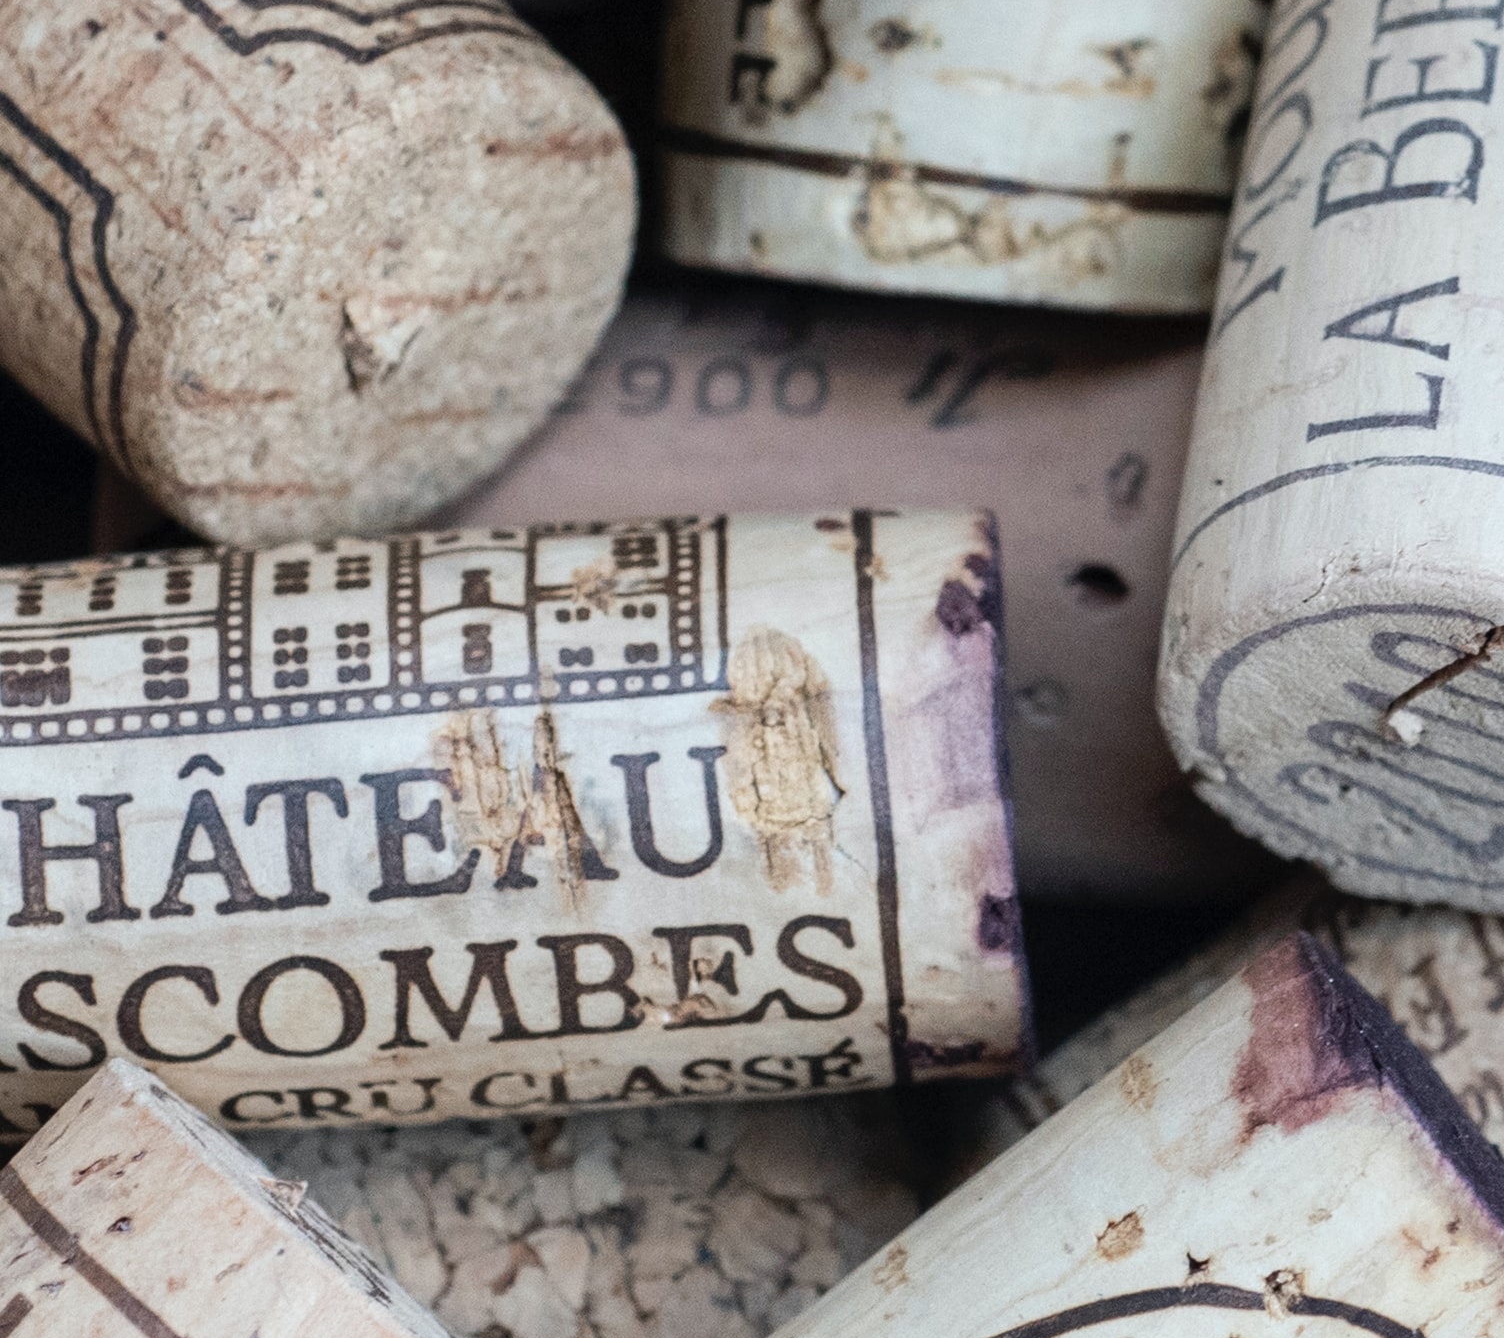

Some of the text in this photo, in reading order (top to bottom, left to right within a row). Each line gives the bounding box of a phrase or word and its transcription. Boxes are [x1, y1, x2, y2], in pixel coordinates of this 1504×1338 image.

[1306, 275, 1462, 443] LA
[216, 1074, 446, 1134] CRU
[468, 1033, 872, 1117] CLASSÉ
